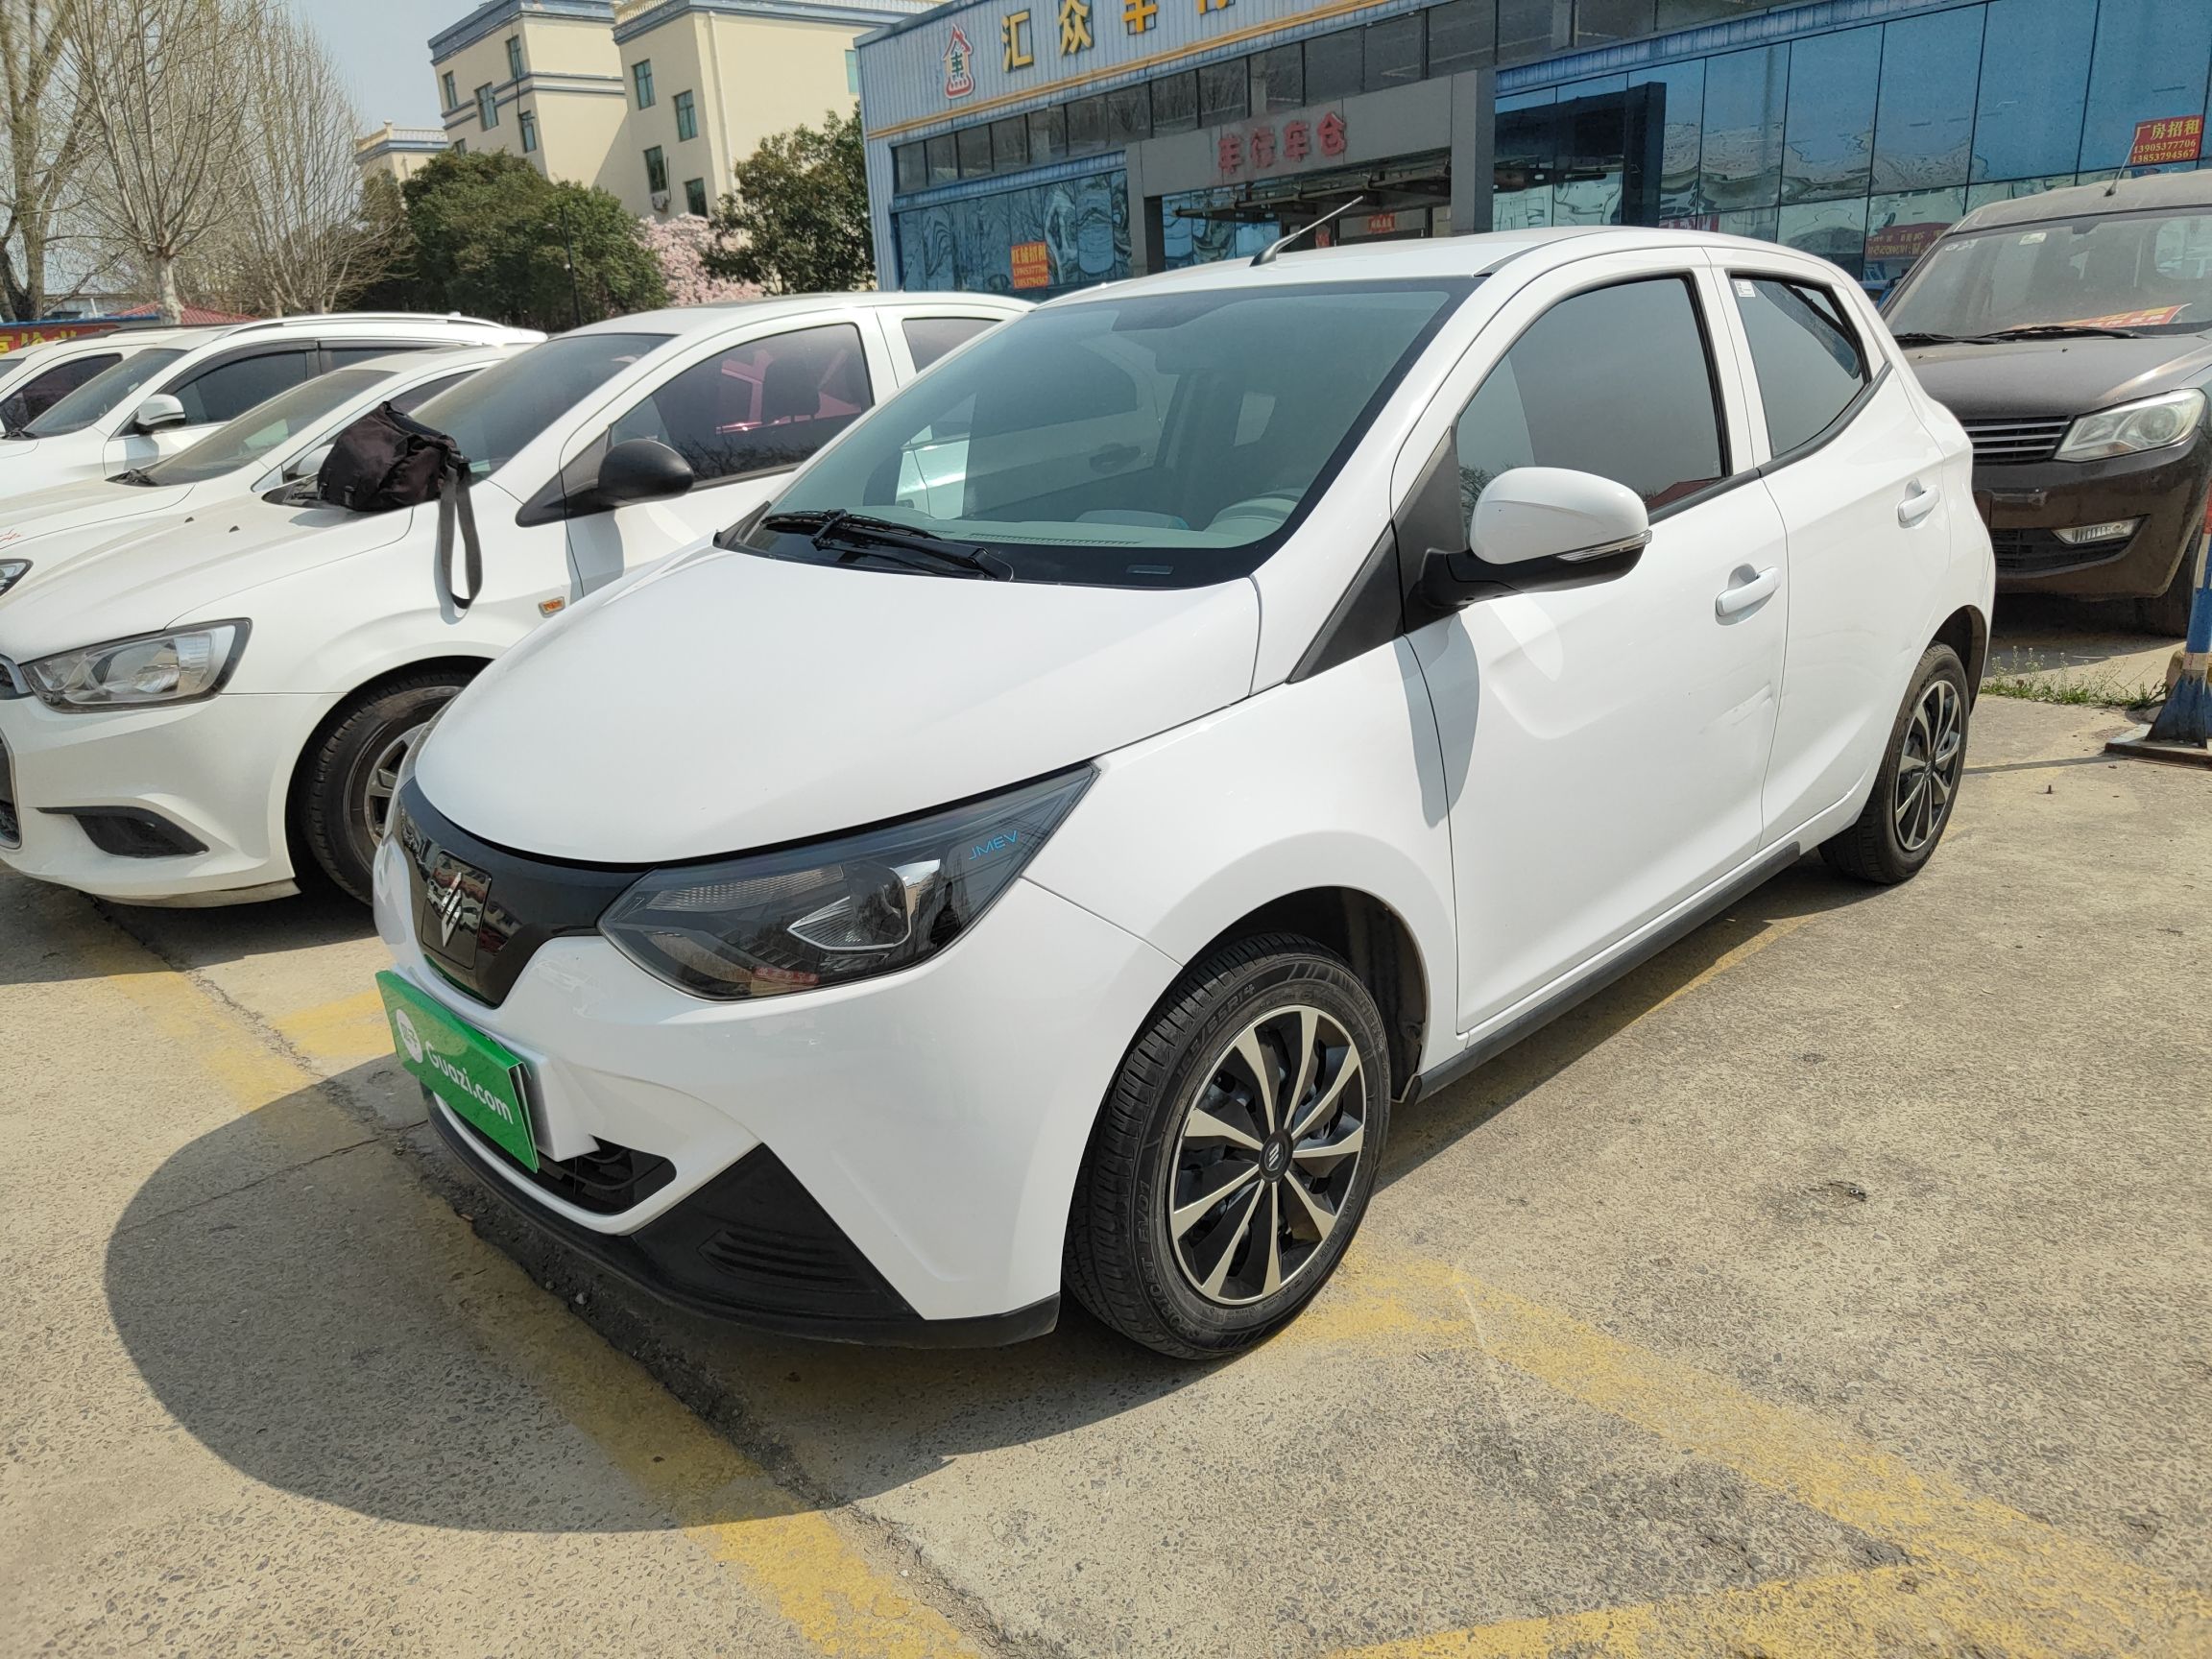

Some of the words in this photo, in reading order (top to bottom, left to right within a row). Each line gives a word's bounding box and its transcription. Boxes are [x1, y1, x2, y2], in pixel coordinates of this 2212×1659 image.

[2134, 119, 2200, 141] 厂房招租
[2131, 150, 2195, 163] 13853794567
[2133, 139, 2197, 154] 13905377706
[969, 830, 1017, 860] JMEV
[425, 1041, 514, 1124] Guazi.com
